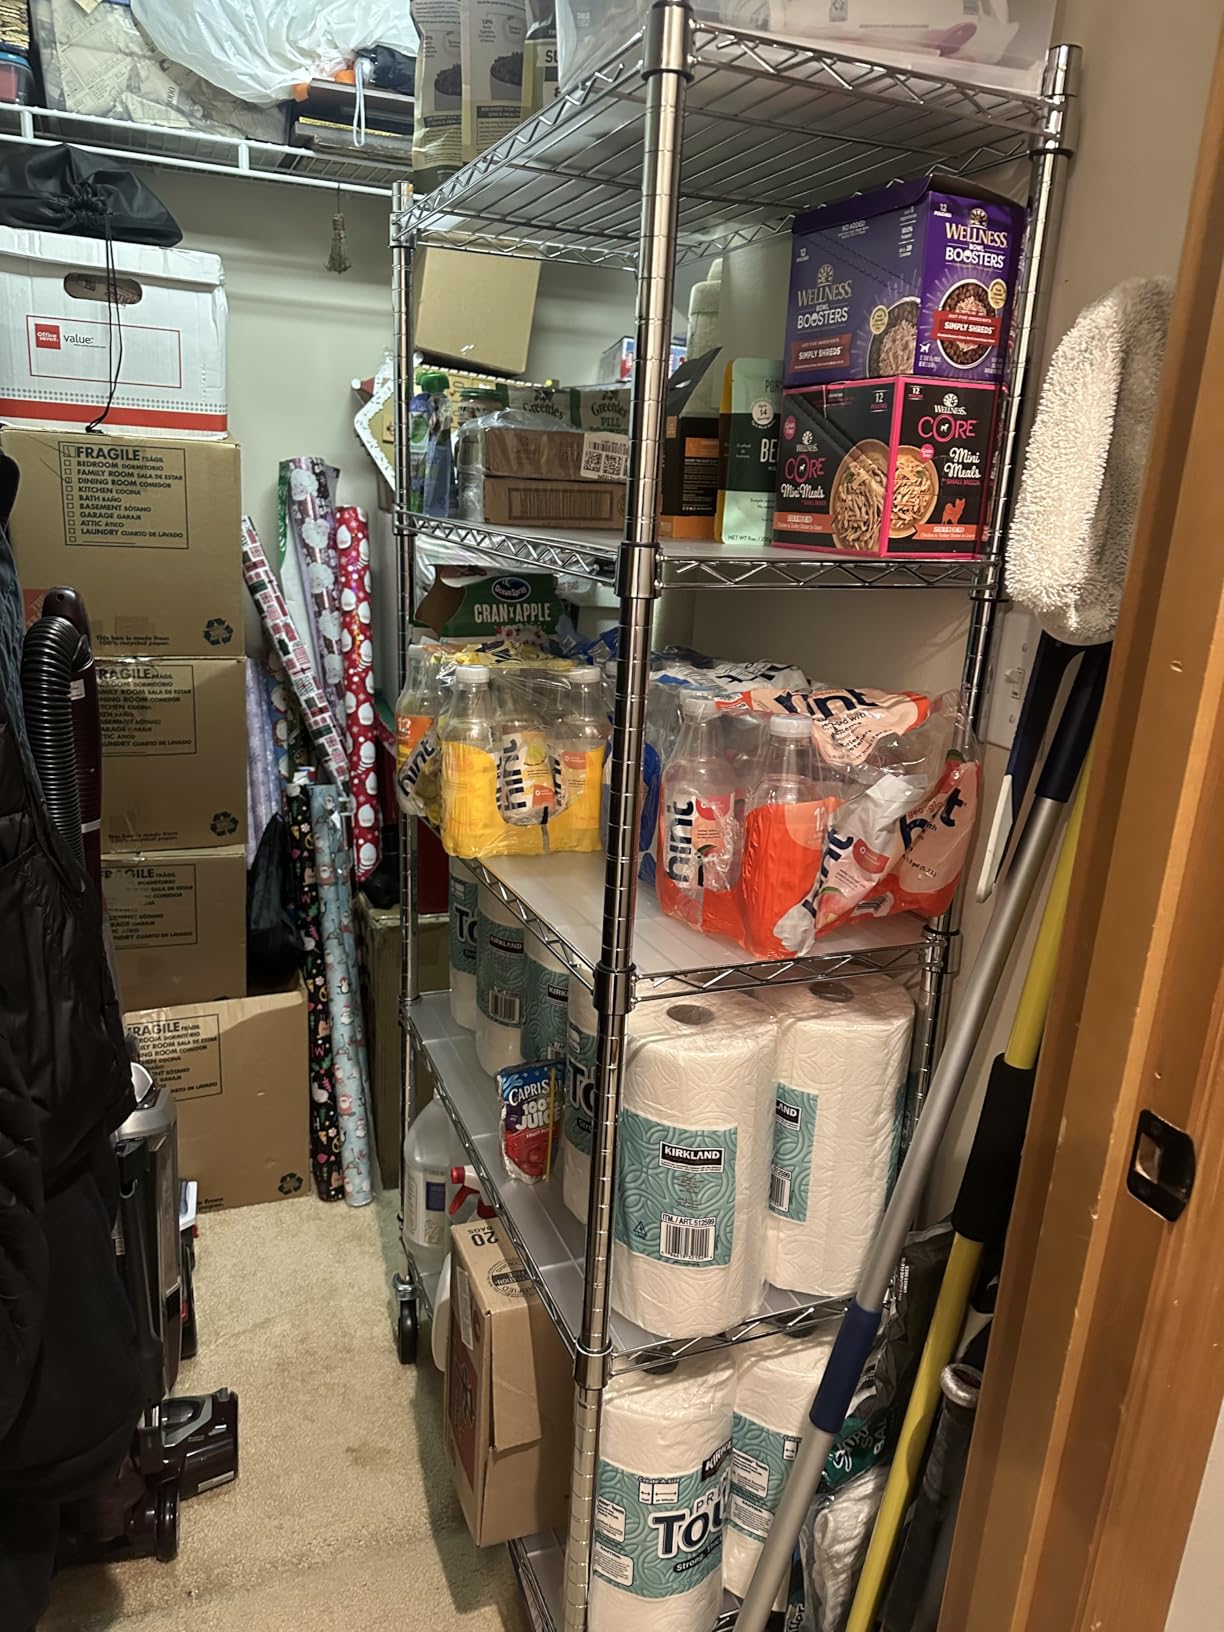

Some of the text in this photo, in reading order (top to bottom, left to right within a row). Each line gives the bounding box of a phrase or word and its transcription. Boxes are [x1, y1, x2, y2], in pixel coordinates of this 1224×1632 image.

[945, 222, 1008, 248] WELLNESS
[945, 247, 1005, 268] BOOSTERS
[798, 280, 852, 307] WELLNESS
[798, 307, 848, 328] BOOSTERS
[875, 392, 884, 403] 12
[934, 405, 967, 415] WELLNESS
[918, 414, 977, 443] CORE
[77, 446, 140, 461] FRAGILE
[949, 447, 980, 463] Mini
[77, 460, 118, 469] BEDROOM
[785, 453, 826, 483] CORE
[944, 462, 982, 479] Meals
[77, 469, 106, 477] FAMILY
[108, 470, 134, 478] ROOM
[78, 477, 109, 486] DINING
[111, 479, 137, 487] ROOM
[79, 486, 113, 494] KITCHEN
[781, 483, 825, 498] Mini Meals
[79, 494, 100, 502] BATH
[80, 503, 122, 511] BASEMENT
[80, 511, 114, 519] GARAGE
[81, 528, 119, 536] LAUNDRY
[474, 603, 508, 623] CRAN
[515, 602, 551, 622] APPLE
[98, 668, 152, 679] RAGILE
[490, 935, 522, 950] KIRKLAND
[128, 1022, 180, 1036] RAGILE
[664, 1146, 720, 1159] KIRKLAND
[468, 1226, 493, 1234] BAGS
[471, 1231, 499, 1247] 20
